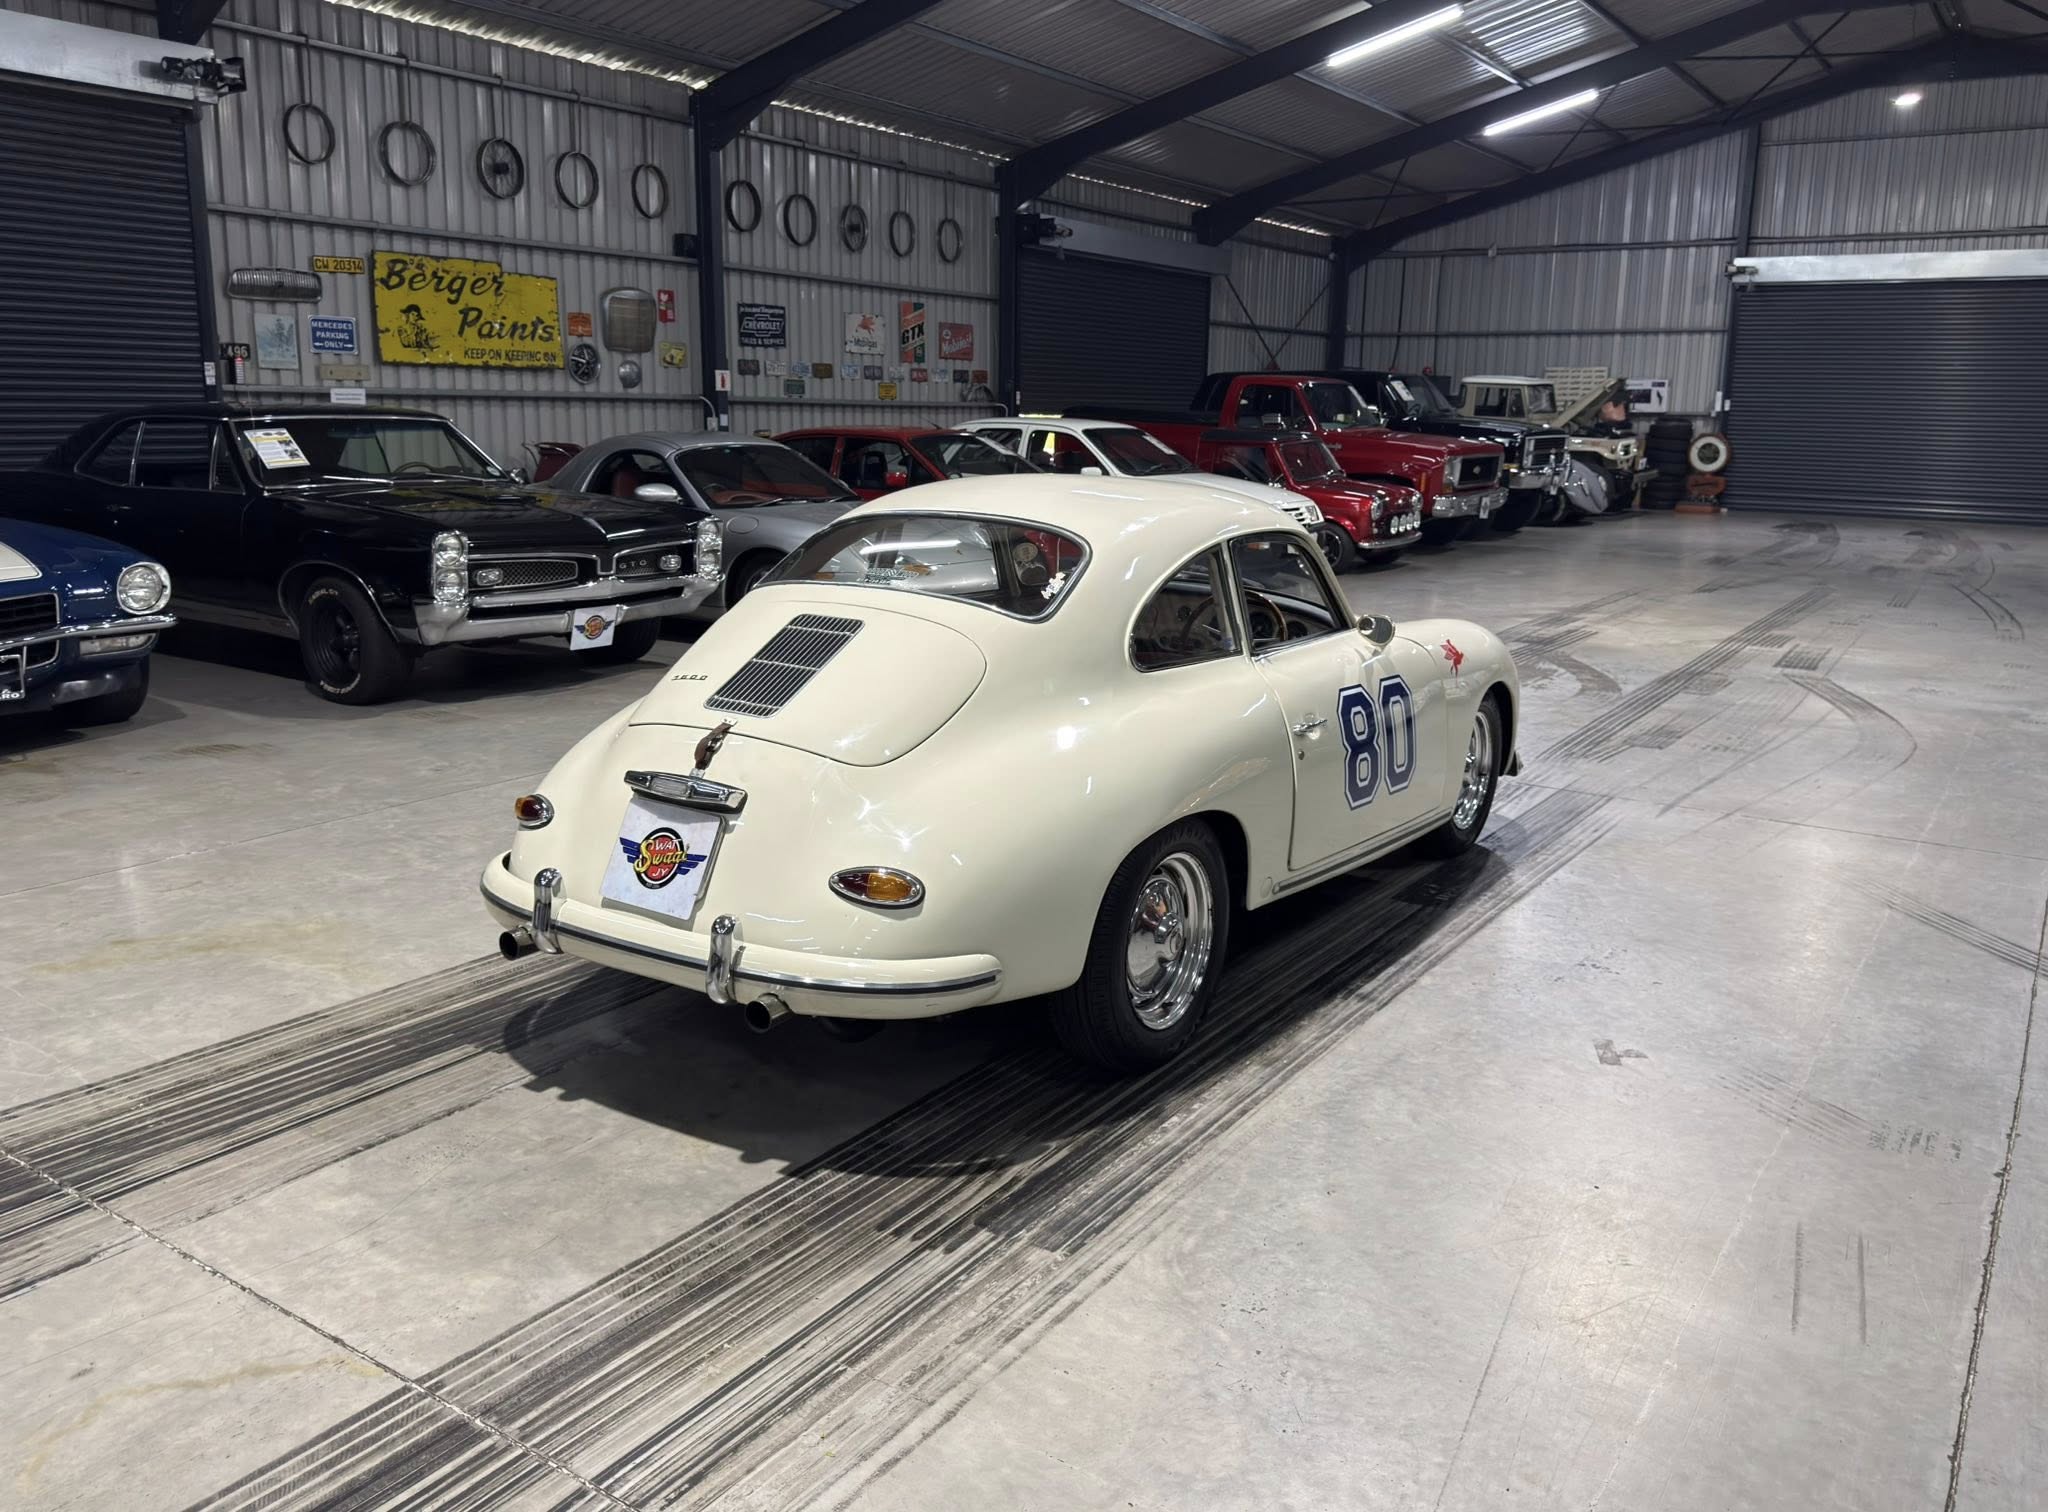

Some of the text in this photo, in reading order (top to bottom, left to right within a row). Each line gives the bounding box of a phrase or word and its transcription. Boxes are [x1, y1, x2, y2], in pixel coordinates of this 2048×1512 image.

[314, 259, 329, 270] CW
[380, 258, 505, 305] Berger
[311, 320, 353, 330] MERCEDES
[457, 306, 555, 343] Paints
[316, 331, 350, 340] PARKING
[902, 321, 925, 346] GTX
[324, 341, 344, 349] ONLY
[464, 348, 487, 360] KEEP
[488, 349, 502, 361] ON
[505, 350, 542, 362] KEEPING
[619, 559, 647, 569] GTO
[1337, 674, 1417, 811] 80
[655, 838, 682, 851] WAT
[652, 867, 669, 877] JY
